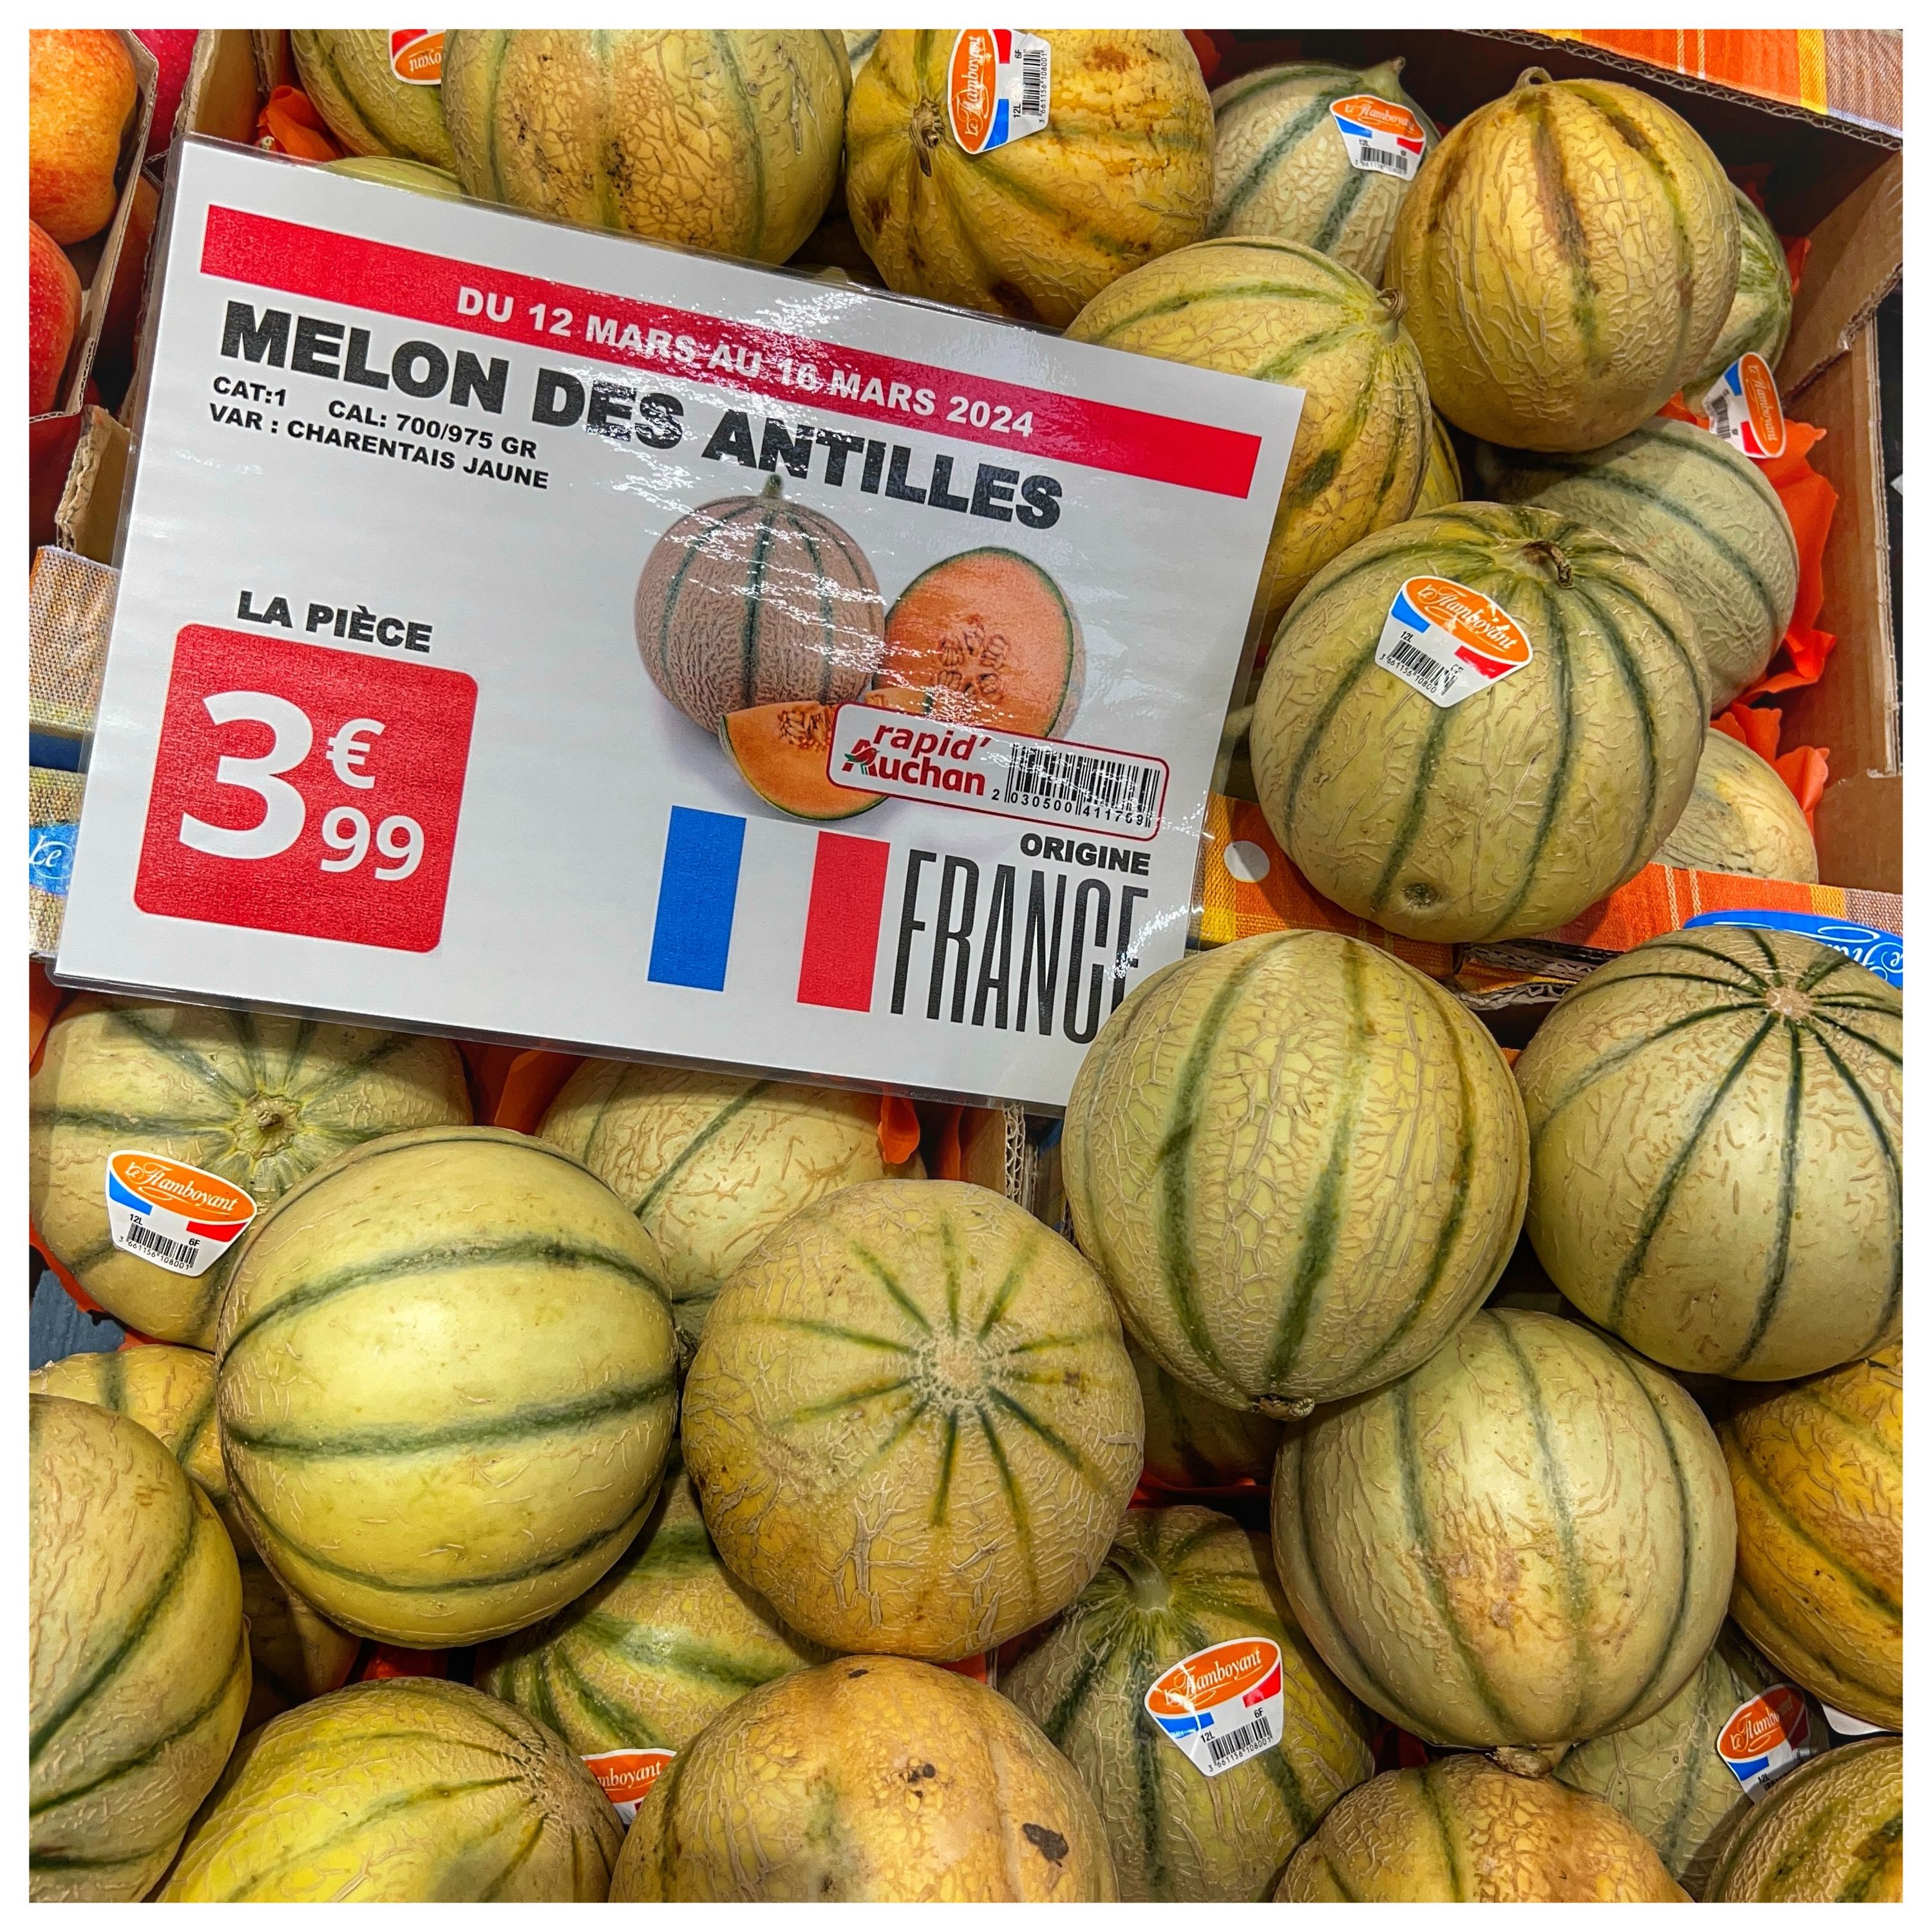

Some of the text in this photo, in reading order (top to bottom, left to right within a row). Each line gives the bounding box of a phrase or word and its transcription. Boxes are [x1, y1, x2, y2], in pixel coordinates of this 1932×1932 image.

[409, 50, 442, 73] oyant
[1015, 50, 1023, 59] 6F
[1013, 104, 1021, 118] 12L
[457, 287, 514, 323] DU
[529, 304, 573, 337] 12
[585, 315, 696, 365] MARS
[707, 343, 762, 378] AU
[830, 369, 936, 417] MARS
[945, 397, 1036, 438] 2024
[213, 376, 538, 460] CAT:1 CAL: 700/975 GR
[220, 300, 1063, 531] MELON DES ANTILLES
[209, 403, 263, 431] VAR
[287, 419, 457, 470] CHARENTAIS
[463, 457, 551, 490] JAUNE
[237, 590, 433, 654] LA PIÈCE
[1400, 630, 1414, 643] 12L
[1426, 586, 1519, 650] Flamboyant
[179, 691, 314, 860] 3
[319, 806, 426, 882] 99
[842, 738, 987, 796] Auchan
[1020, 833, 1151, 876] ORIGINE
[890, 849, 1149, 1045] FRANCE
[137, 1162, 239, 1213] Flamboyant
[129, 1214, 143, 1226] 12L
[188, 1237, 201, 1247] 6F
[1200, 1730, 1216, 1743] 12L
[1253, 1707, 1264, 1719] 6F
[598, 1760, 662, 1788] mboyant
